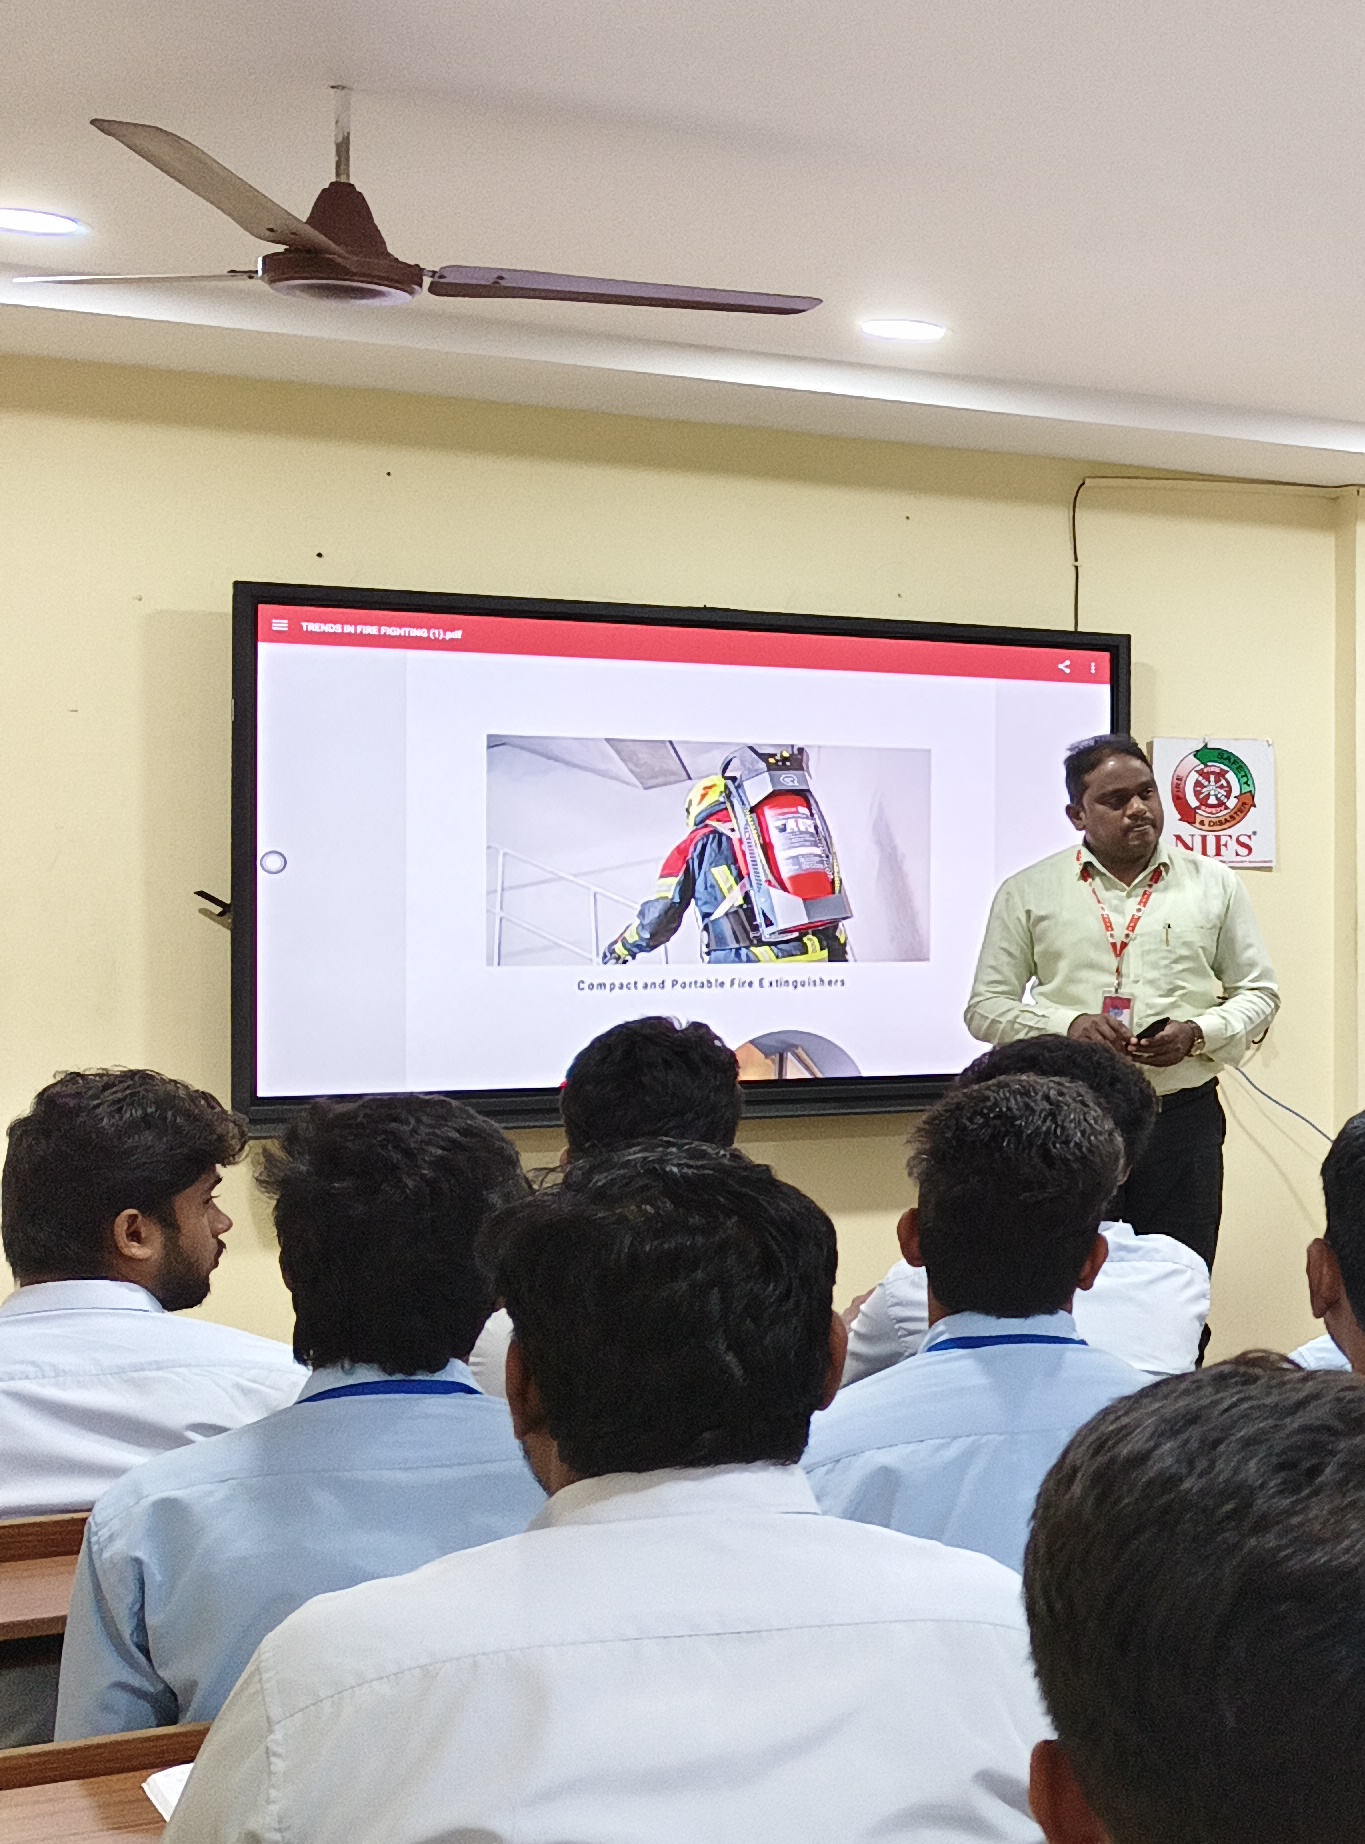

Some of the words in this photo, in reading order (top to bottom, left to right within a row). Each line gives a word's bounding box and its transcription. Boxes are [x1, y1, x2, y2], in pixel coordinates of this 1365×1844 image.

[300, 621, 342, 632] TRENDS
[343, 624, 354, 633] IN
[356, 624, 379, 634] FIRE
[380, 625, 428, 637] FIGHTING
[429, 628, 462, 640] (1).pdf
[1217, 751, 1251, 787] SAFETY
[1208, 801, 1249, 828] DISASTER
[1173, 834, 1253, 858] NIFS
[577, 979, 637, 992] Compact
[642, 979, 665, 990] and
[671, 978, 725, 989] Portable
[729, 977, 753, 988] Fire
[758, 977, 844, 990] Extinguishers
